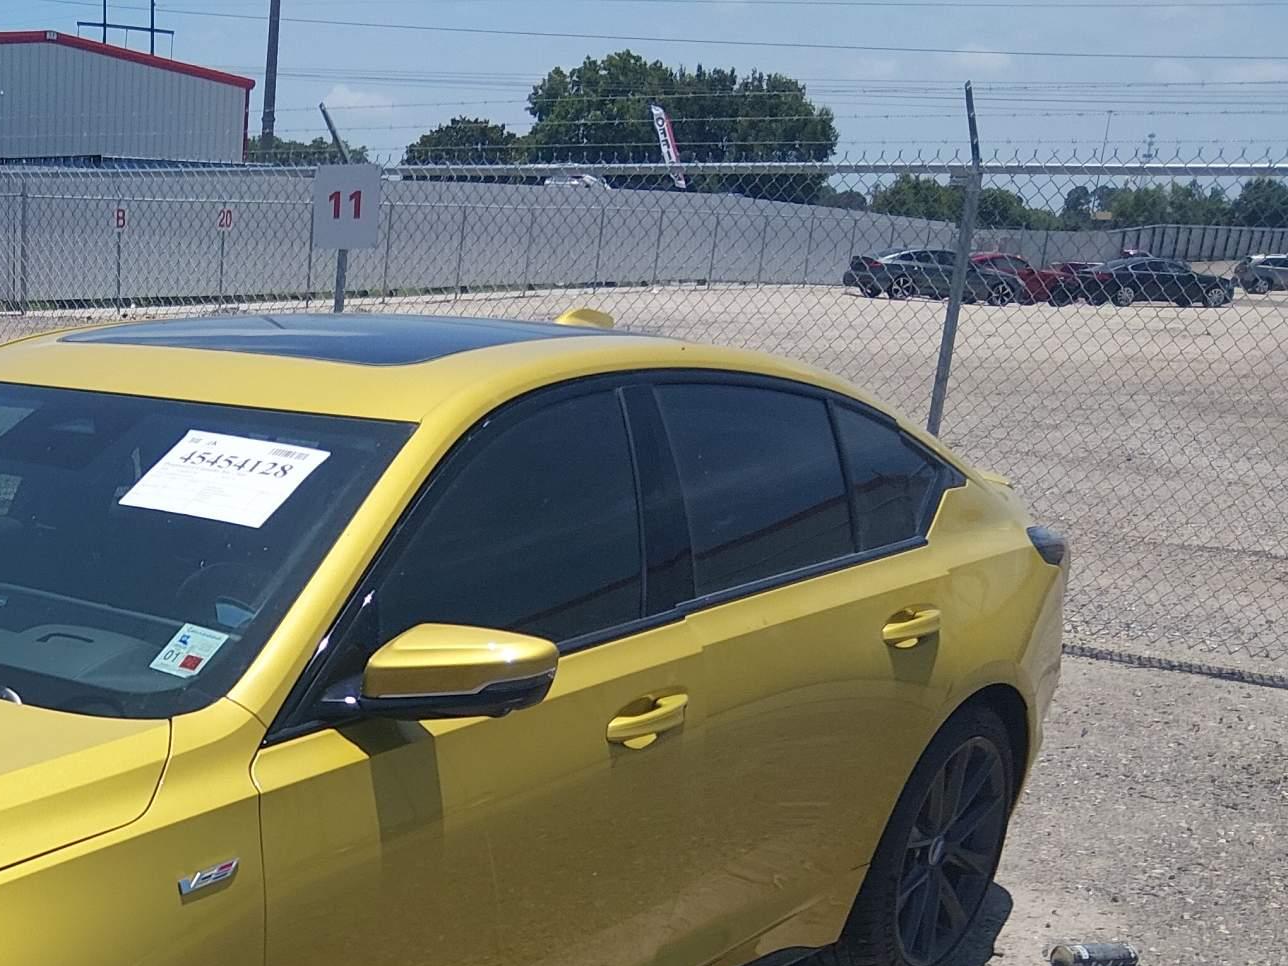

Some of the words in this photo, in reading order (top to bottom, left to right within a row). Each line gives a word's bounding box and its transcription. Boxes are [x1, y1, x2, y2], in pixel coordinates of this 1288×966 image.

[328, 190, 362, 220] 11
[116, 209, 126, 228] B
[218, 209, 232, 228] 20
[178, 450, 294, 480] 45454128
[163, 650, 181, 663] 01
